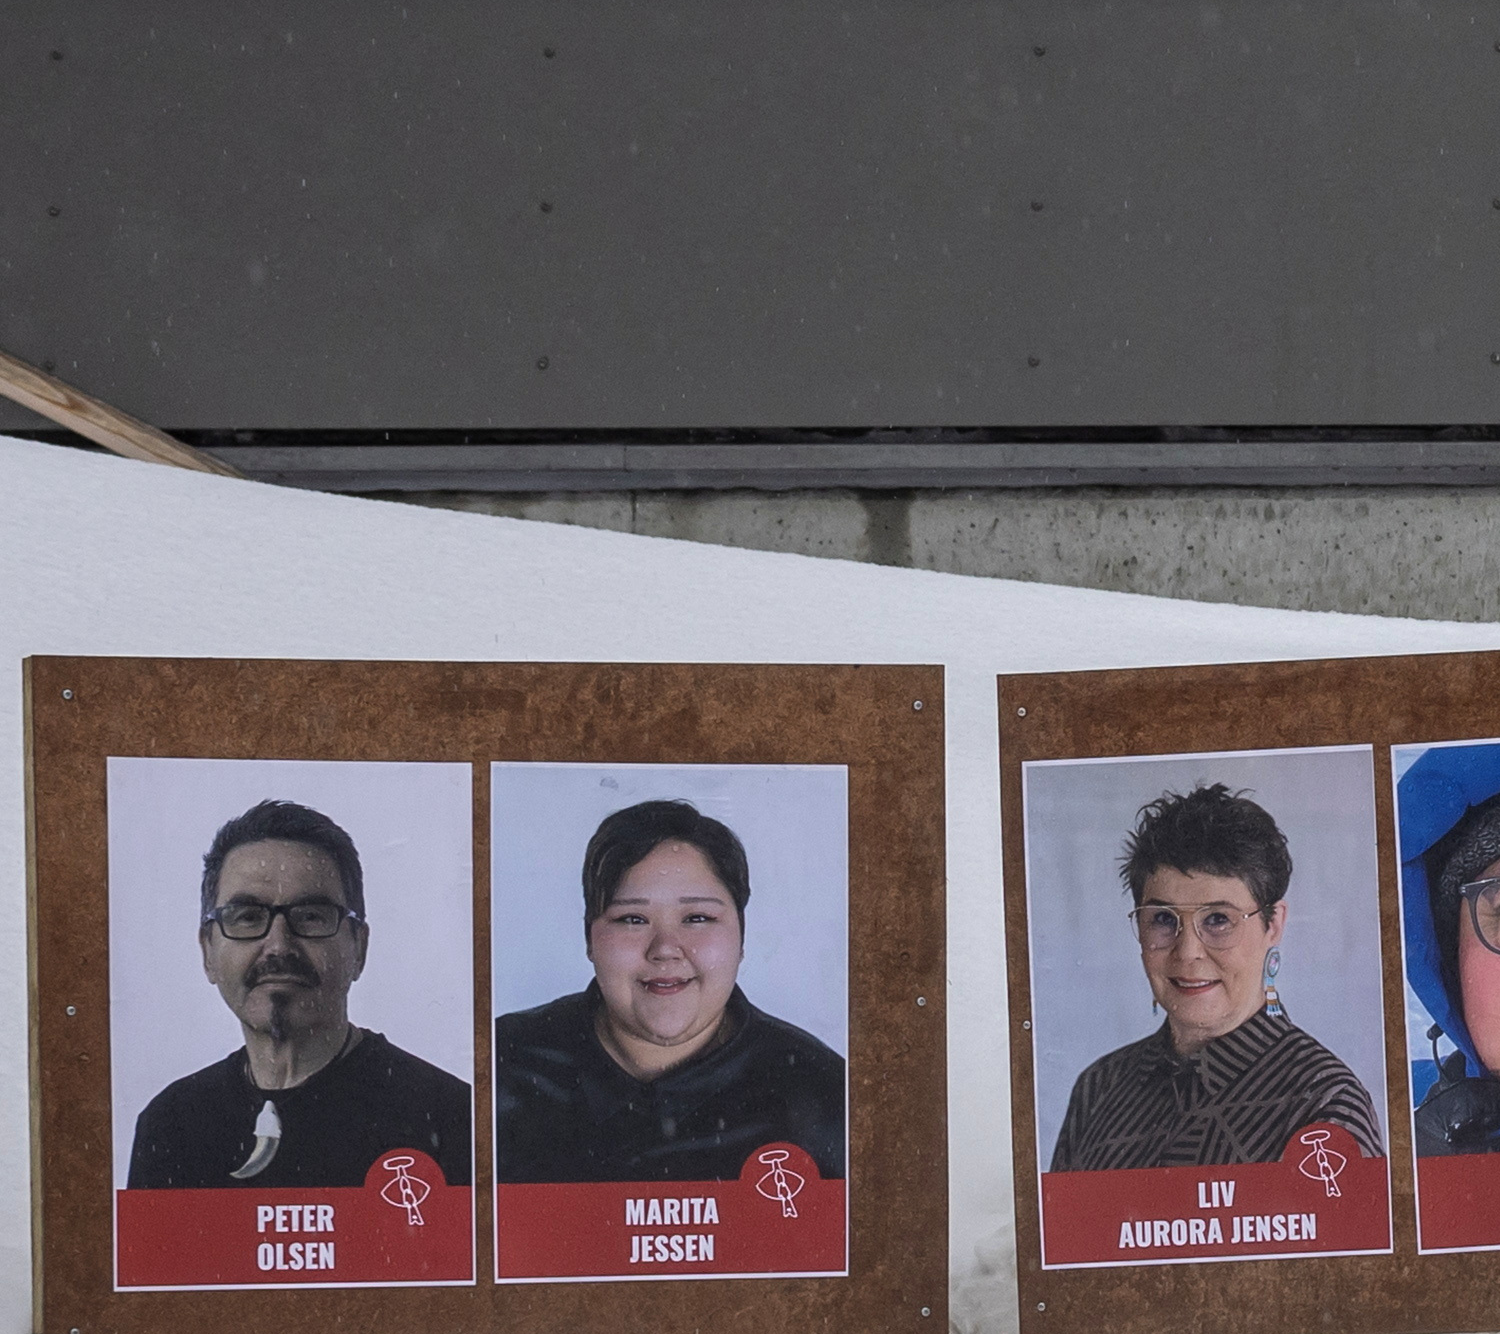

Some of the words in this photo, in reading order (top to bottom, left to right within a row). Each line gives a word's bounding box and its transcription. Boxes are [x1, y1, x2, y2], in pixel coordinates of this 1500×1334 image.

[1198, 1180, 1236, 1209] LIV
[257, 1204, 335, 1234] PETER
[625, 1196, 720, 1227] MARITA
[1118, 1218, 1224, 1250] AURORA
[1230, 1213, 1317, 1244] JENSEN
[257, 1242, 335, 1271] OLSEN
[629, 1234, 714, 1263] JESSEN
